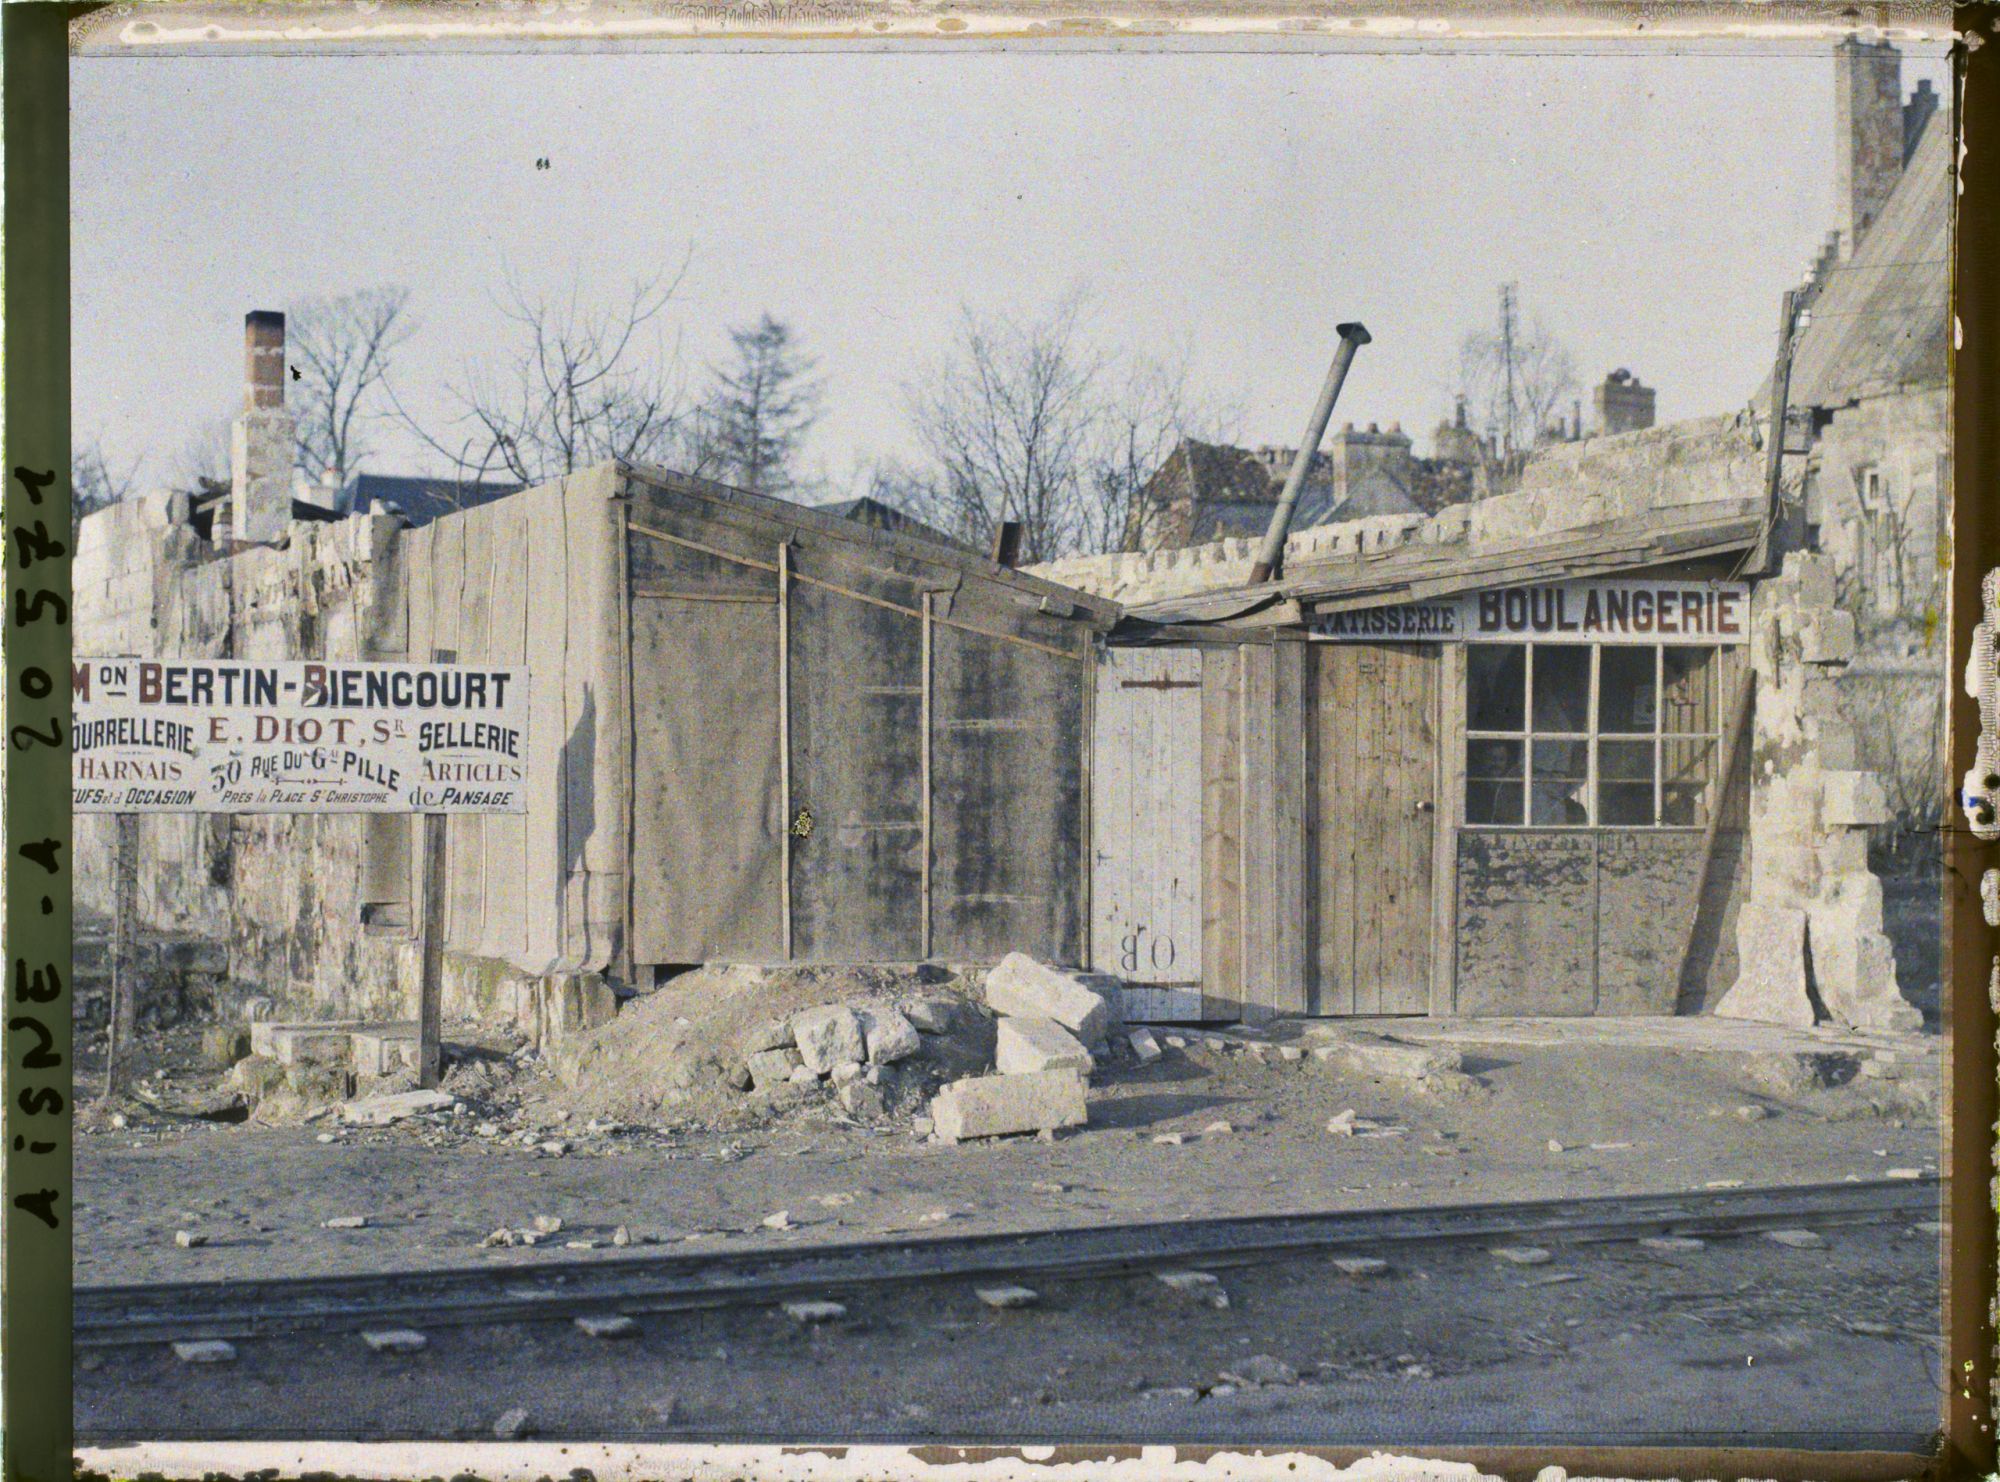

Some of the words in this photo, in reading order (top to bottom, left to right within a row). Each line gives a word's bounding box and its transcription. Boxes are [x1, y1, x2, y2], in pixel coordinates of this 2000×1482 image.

[1478, 588, 1740, 633] BOULANGERIE
[139, 663, 511, 708] BERTIN-BIENCOURT
[419, 721, 519, 758] SELLERIE
[78, 757, 182, 781] HARNAIS
[251, 755, 278, 777] RUE
[284, 751, 302, 770] DU
[342, 751, 400, 792] PILLE
[421, 757, 521, 782] ARTICLES
[72, 788, 104, 804] UFS
[270, 789, 306, 803] PLACE
[326, 790, 390, 804] CHRISTOPHE
[409, 786, 436, 806] de
[440, 787, 513, 805] PANSAGE
